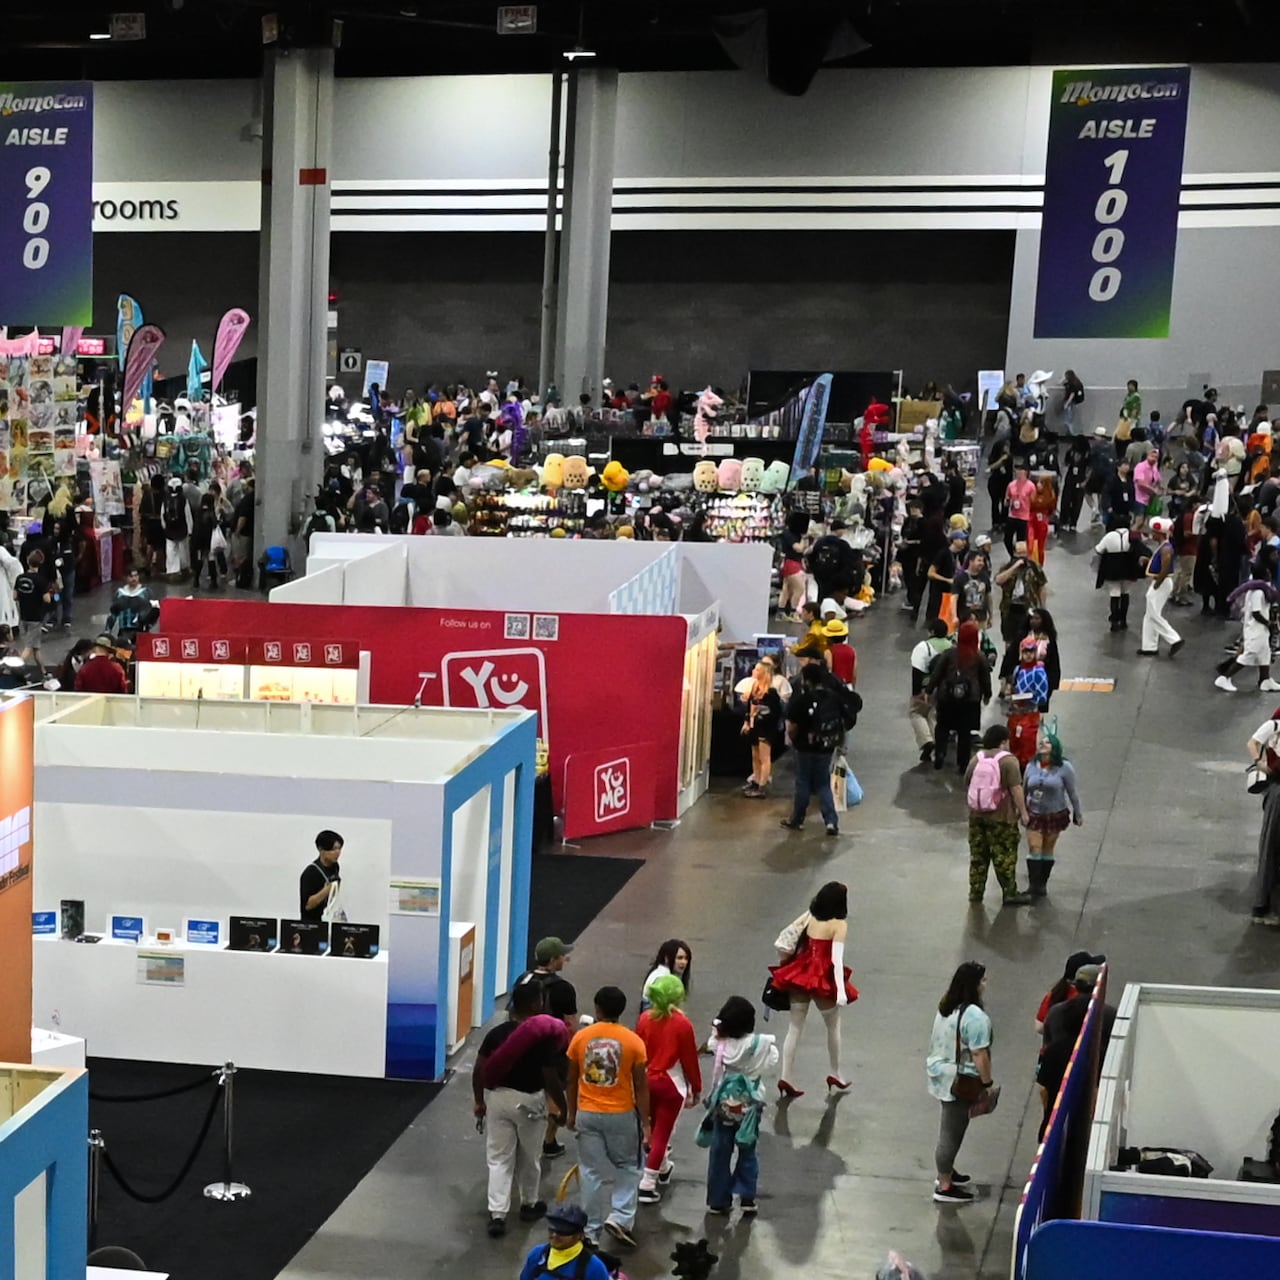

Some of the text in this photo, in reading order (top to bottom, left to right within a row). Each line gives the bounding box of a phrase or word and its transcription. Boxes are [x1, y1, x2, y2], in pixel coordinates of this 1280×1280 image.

[1060, 81, 1179, 104] MomoCon
[5, 127, 68, 145] AISLE
[1078, 119, 1156, 139] AISLE
[23, 166, 51, 269] 900
[1088, 150, 1129, 302] 1000
[440, 618, 491, 630] Follow us on
